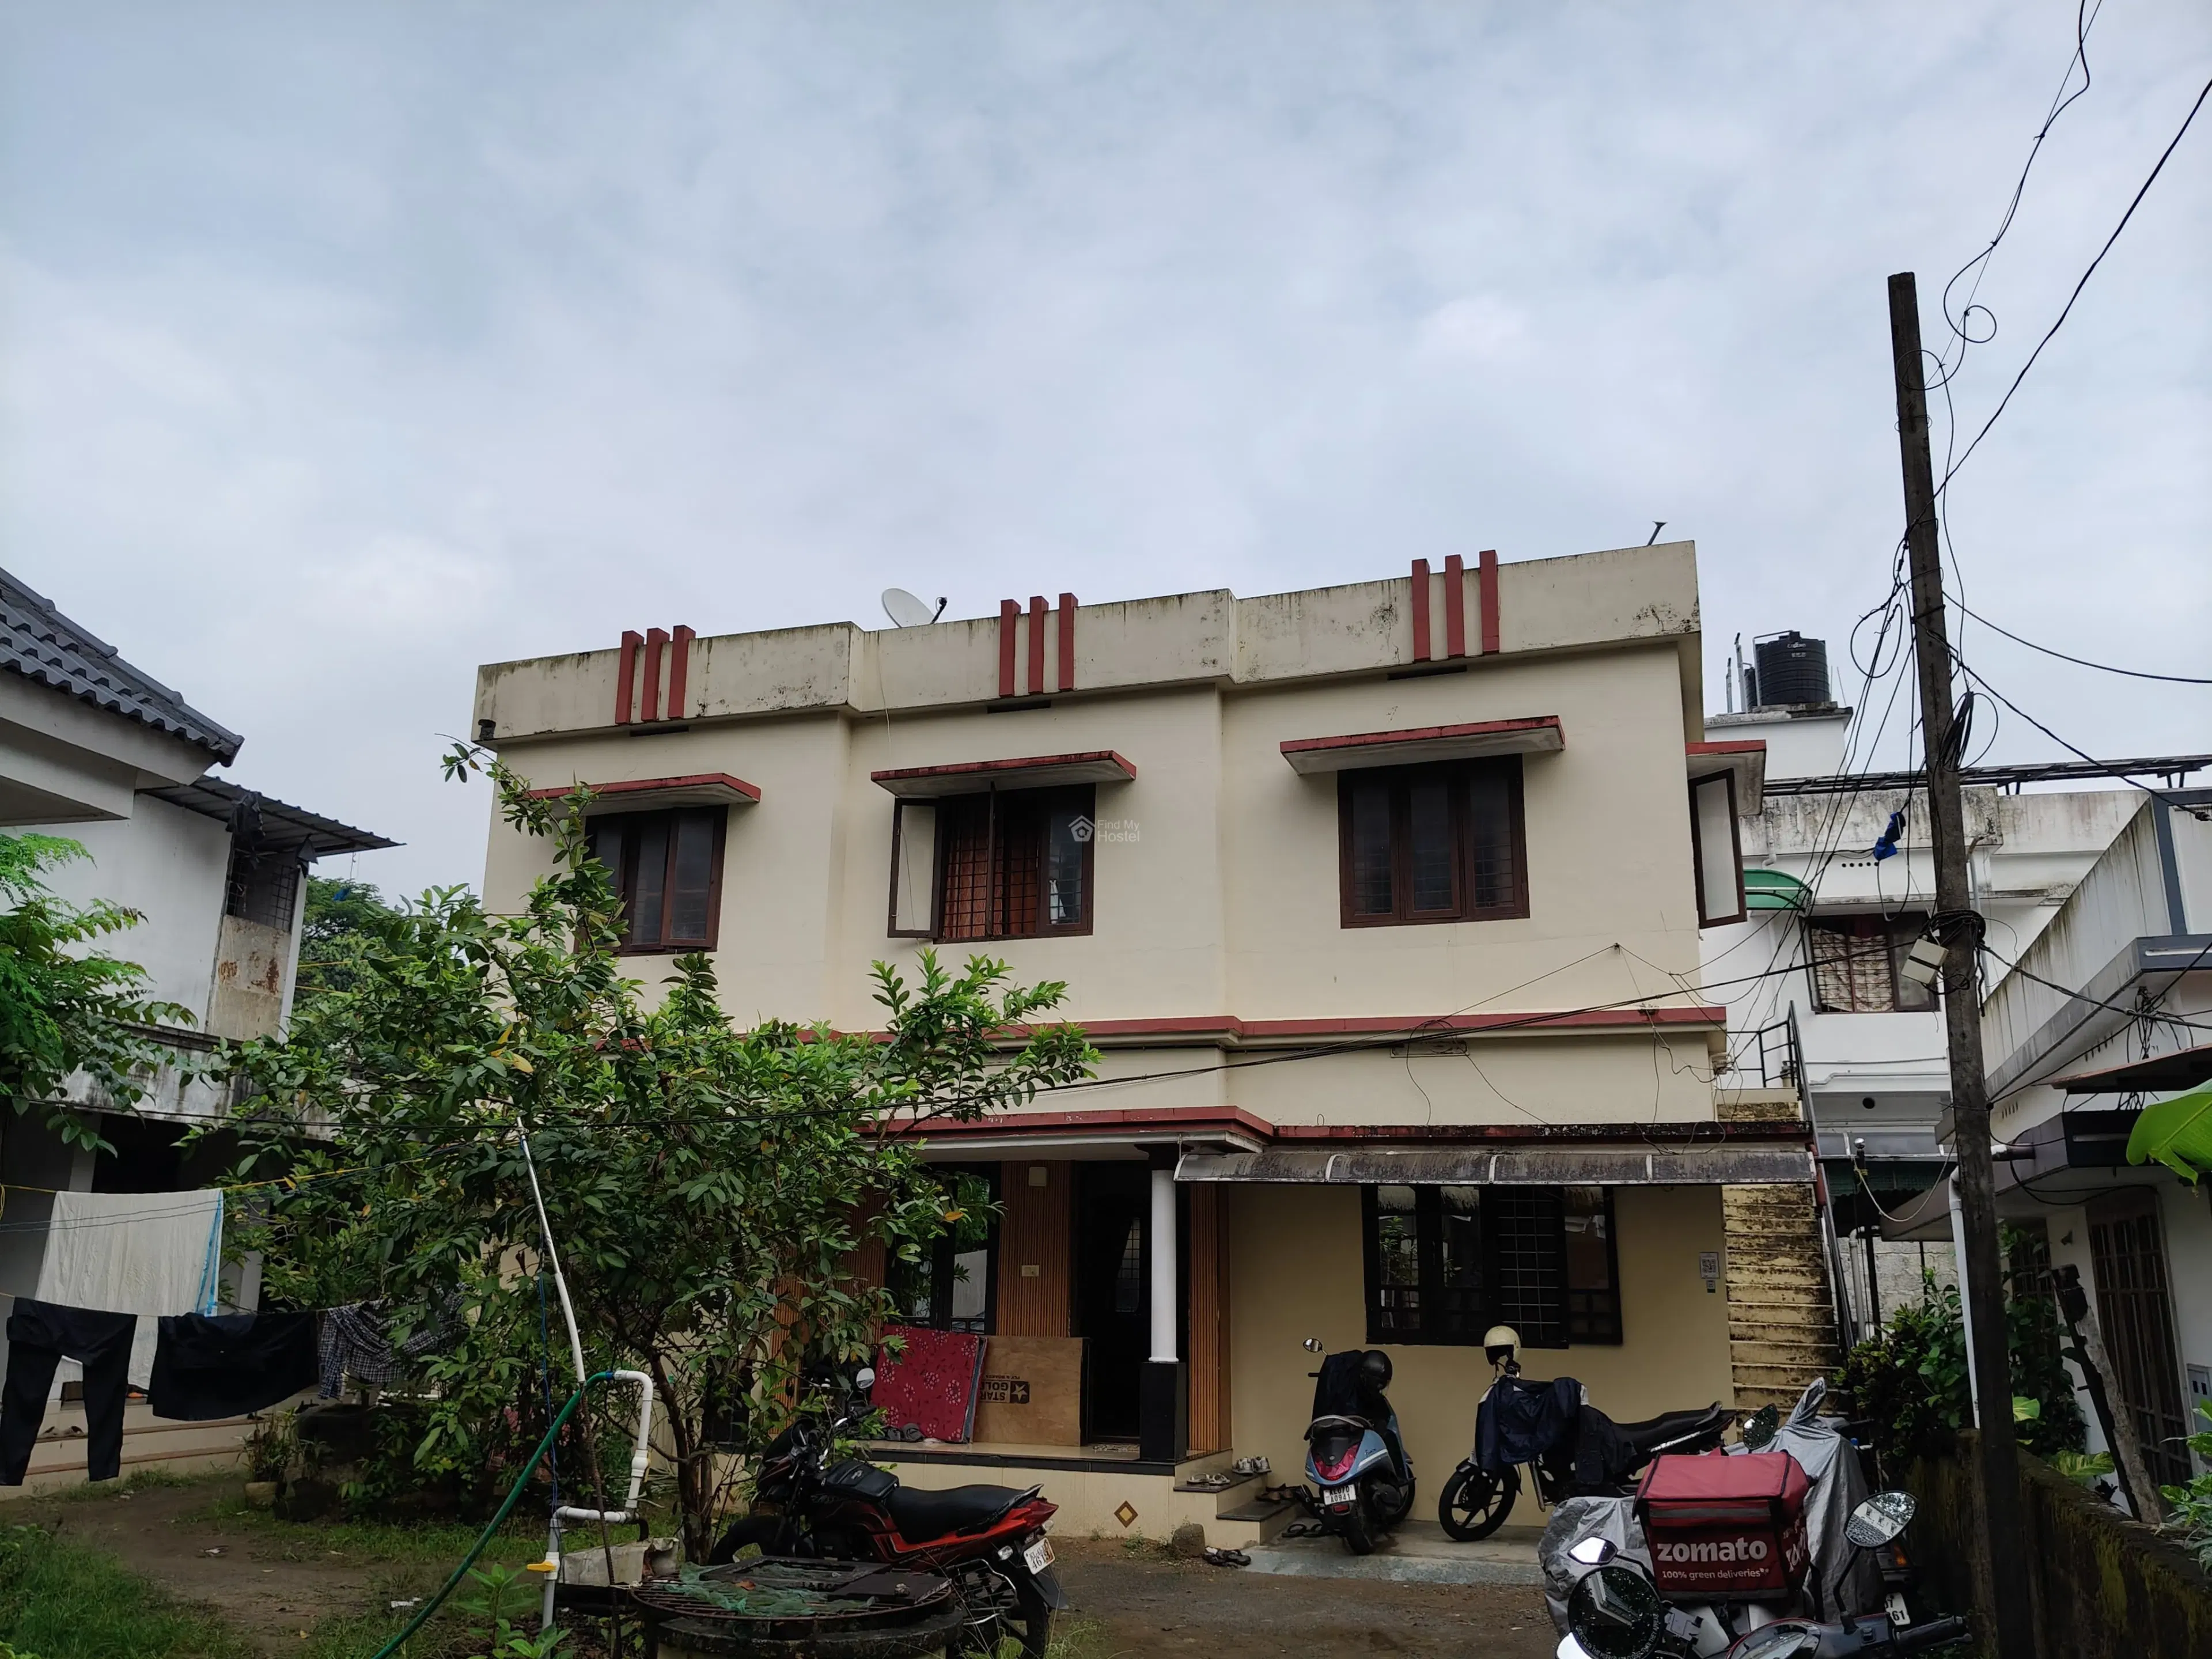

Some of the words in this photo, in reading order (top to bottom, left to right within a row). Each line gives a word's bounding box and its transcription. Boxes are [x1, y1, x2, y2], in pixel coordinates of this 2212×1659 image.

[980, 1391, 1005, 1400] STAR
[1657, 1537, 1767, 1562] zomato
[1662, 1570, 1687, 1579] 100%
[1689, 1571, 1715, 1581] green
[1717, 1568, 1760, 1579] deliveries
